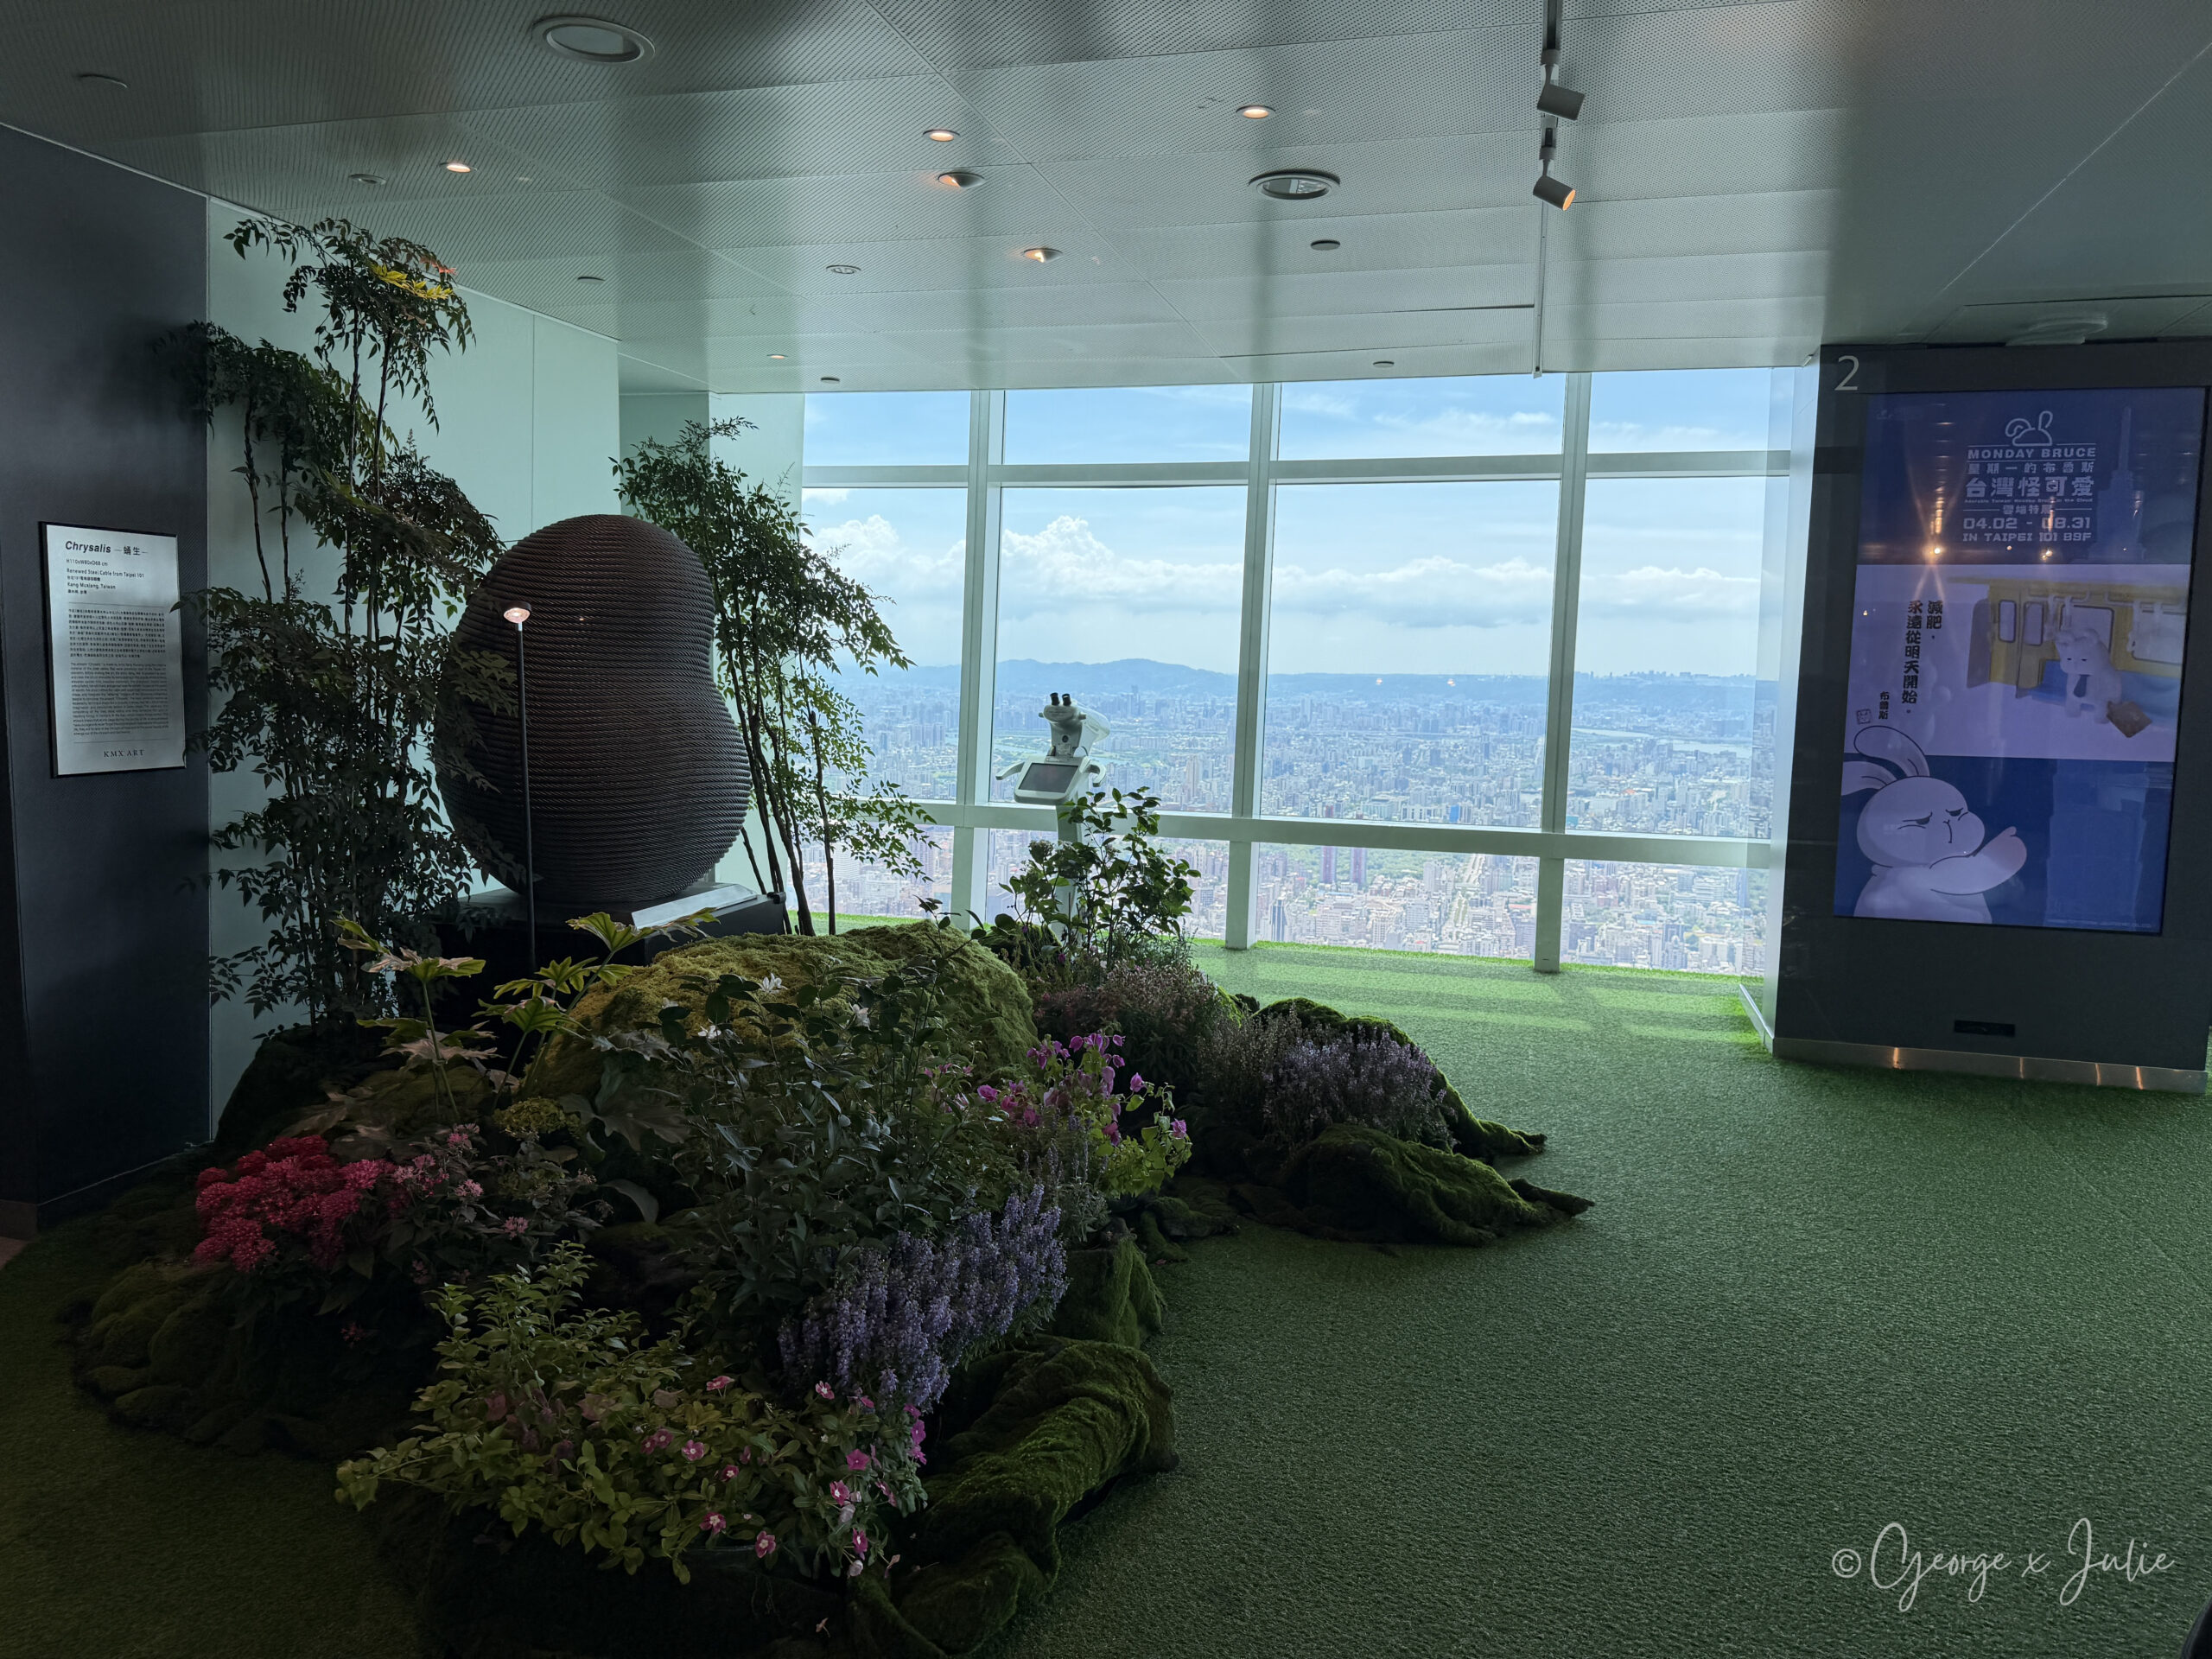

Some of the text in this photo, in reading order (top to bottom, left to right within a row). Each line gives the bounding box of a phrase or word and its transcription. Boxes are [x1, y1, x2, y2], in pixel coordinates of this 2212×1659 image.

[1834, 354, 1859, 391] 2
[1967, 447, 2096, 461] MONDAY BRUCE
[1967, 461, 2094, 474] 星期一的布魯斯
[1966, 475, 2094, 498] 台灣怪可愛
[1962, 518, 2018, 530] 04.02
[1962, 533, 1978, 542] IN
[1984, 532, 2033, 542] TAIPEI
[2039, 532, 2058, 542] 101
[65, 540, 111, 553] Chrysalis
[1878, 690, 1890, 720] 布魯斯
[104, 748, 145, 758] KMX ART
